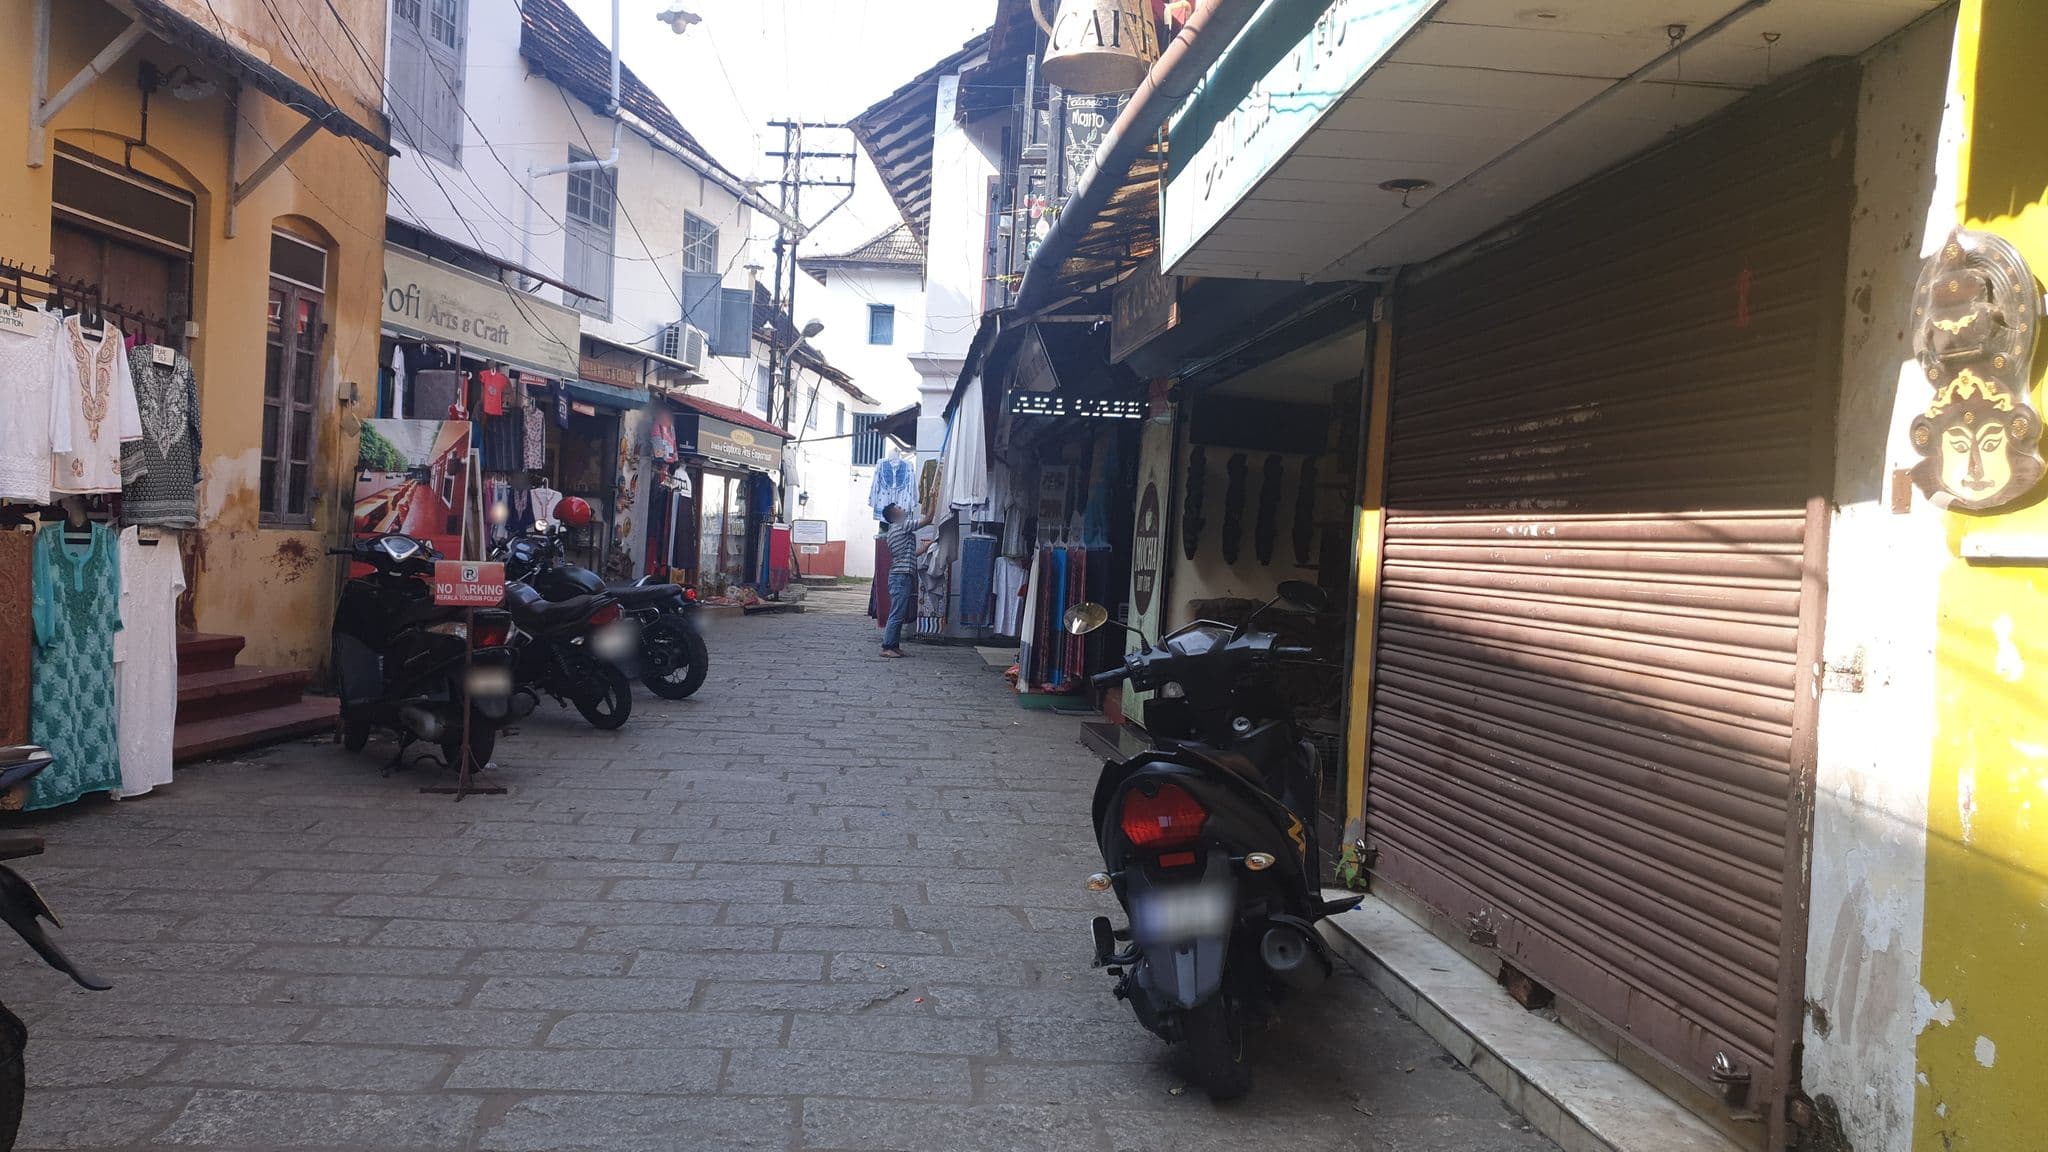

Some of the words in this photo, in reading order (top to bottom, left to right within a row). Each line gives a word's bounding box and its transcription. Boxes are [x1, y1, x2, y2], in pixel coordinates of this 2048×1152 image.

[384, 270, 421, 320] ofi
[428, 304, 458, 331] Arts
[473, 318, 510, 345] Craft
[1135, 537, 1158, 571] MOCHA
[437, 584, 452, 594] NO
